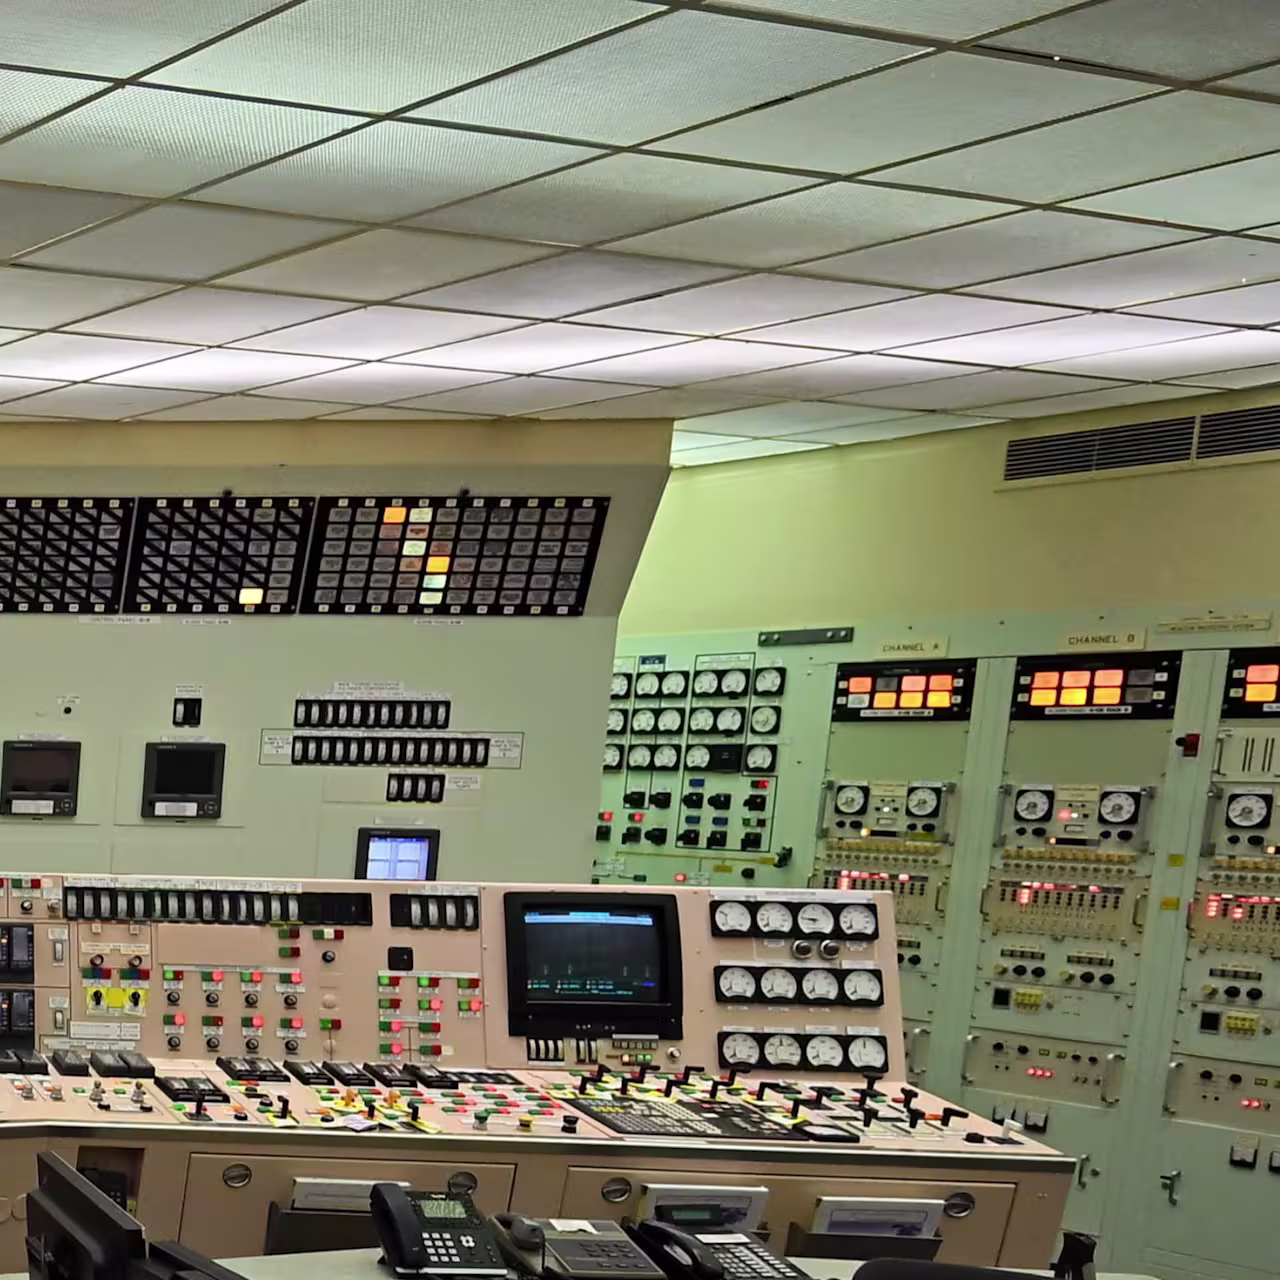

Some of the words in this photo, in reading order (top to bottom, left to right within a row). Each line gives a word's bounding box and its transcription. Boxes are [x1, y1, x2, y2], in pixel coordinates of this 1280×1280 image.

[1068, 635, 1119, 646] CHANNEL
[1127, 633, 1135, 643] B
[882, 643, 925, 653] CHANNEL
[932, 642, 939, 650] A
